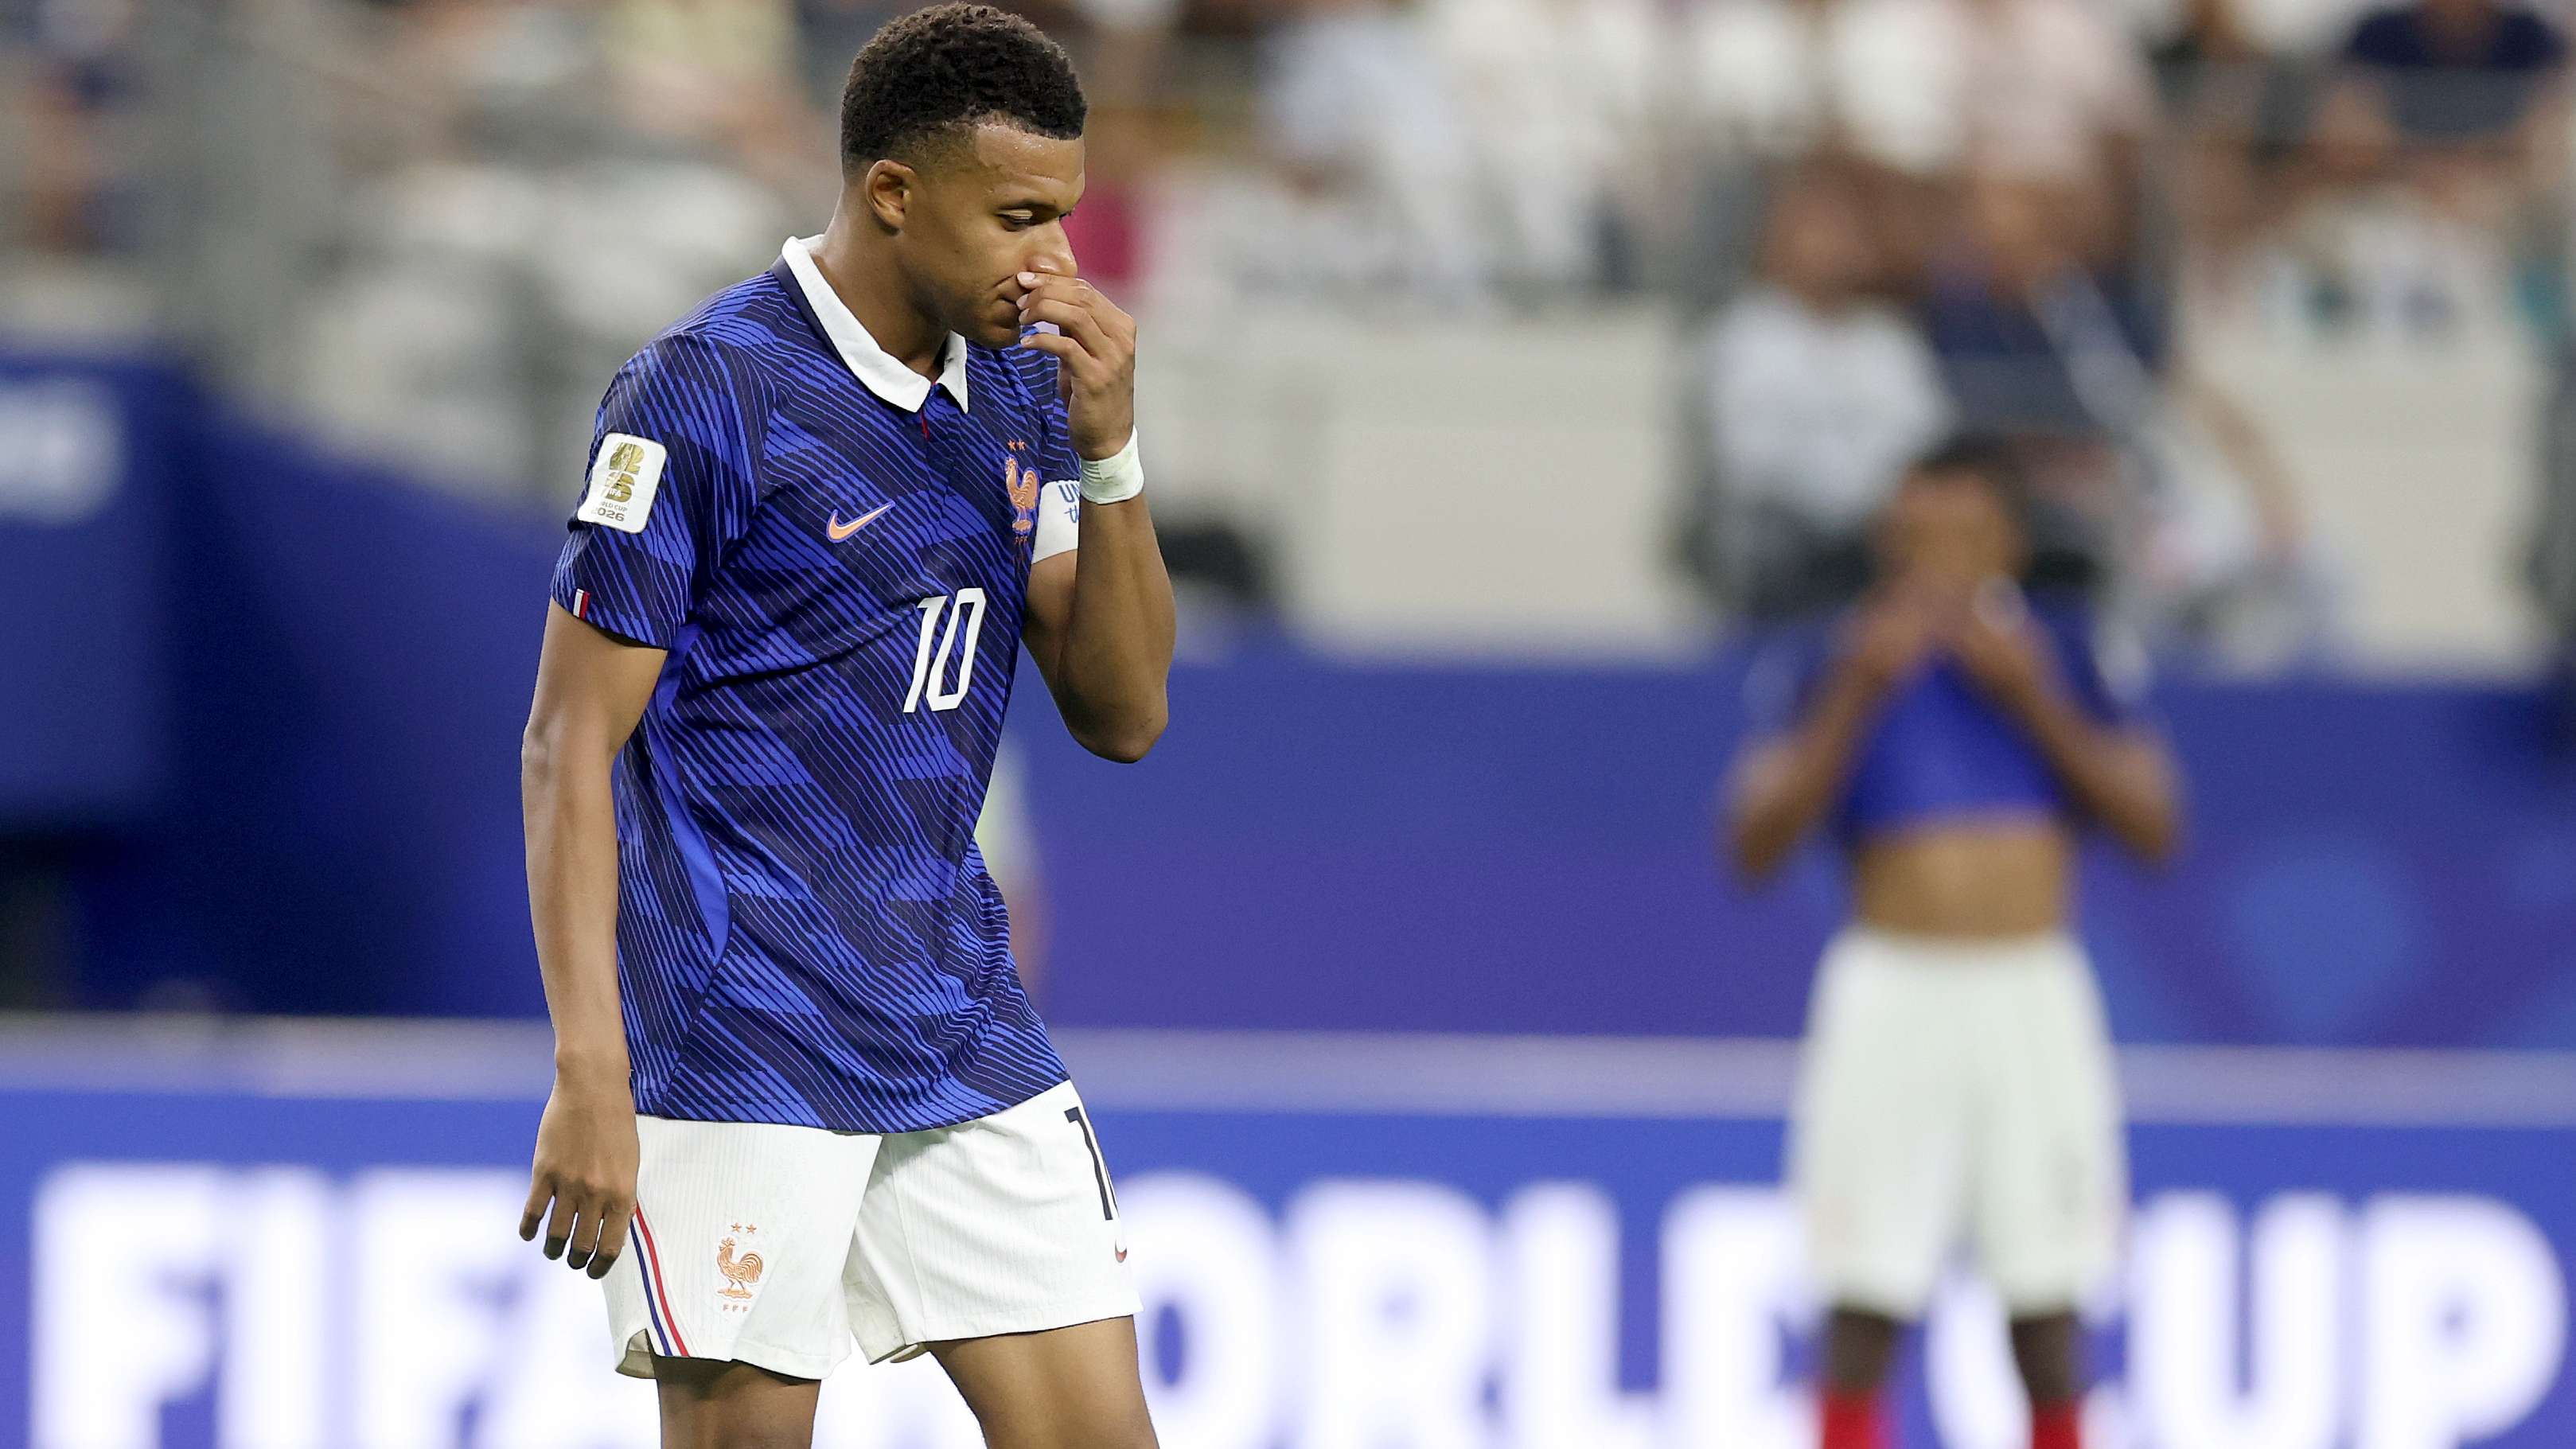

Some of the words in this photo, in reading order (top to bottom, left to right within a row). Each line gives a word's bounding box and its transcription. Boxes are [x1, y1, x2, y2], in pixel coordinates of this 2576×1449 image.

[593, 507, 625, 521] 026
[902, 587, 987, 713] 10
[1063, 1106, 1120, 1221] 1
[812, 1166, 1830, 1449] ORLD
